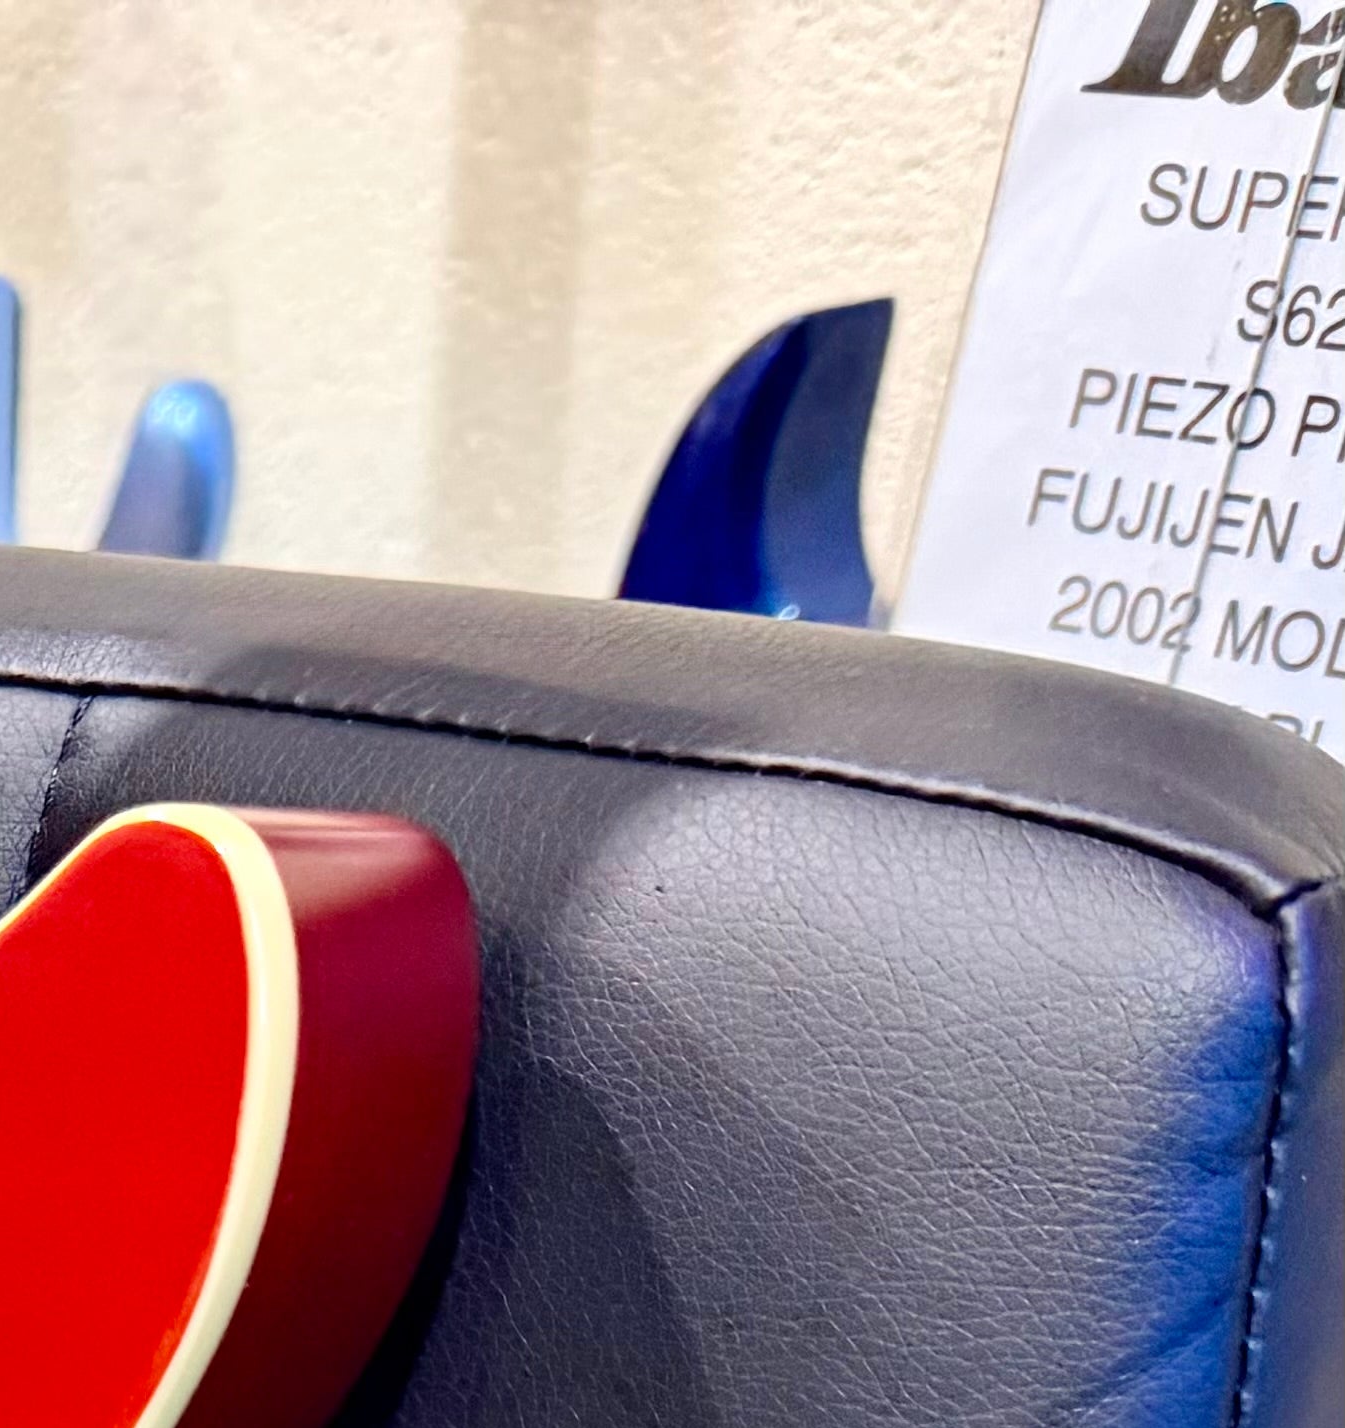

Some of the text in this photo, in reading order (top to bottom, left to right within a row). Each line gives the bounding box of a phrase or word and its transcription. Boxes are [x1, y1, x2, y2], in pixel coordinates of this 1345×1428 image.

[1069, 368, 1276, 450] PIEZO
[1028, 468, 1299, 563] FUJIJEN
[1048, 574, 1202, 654] 2002
